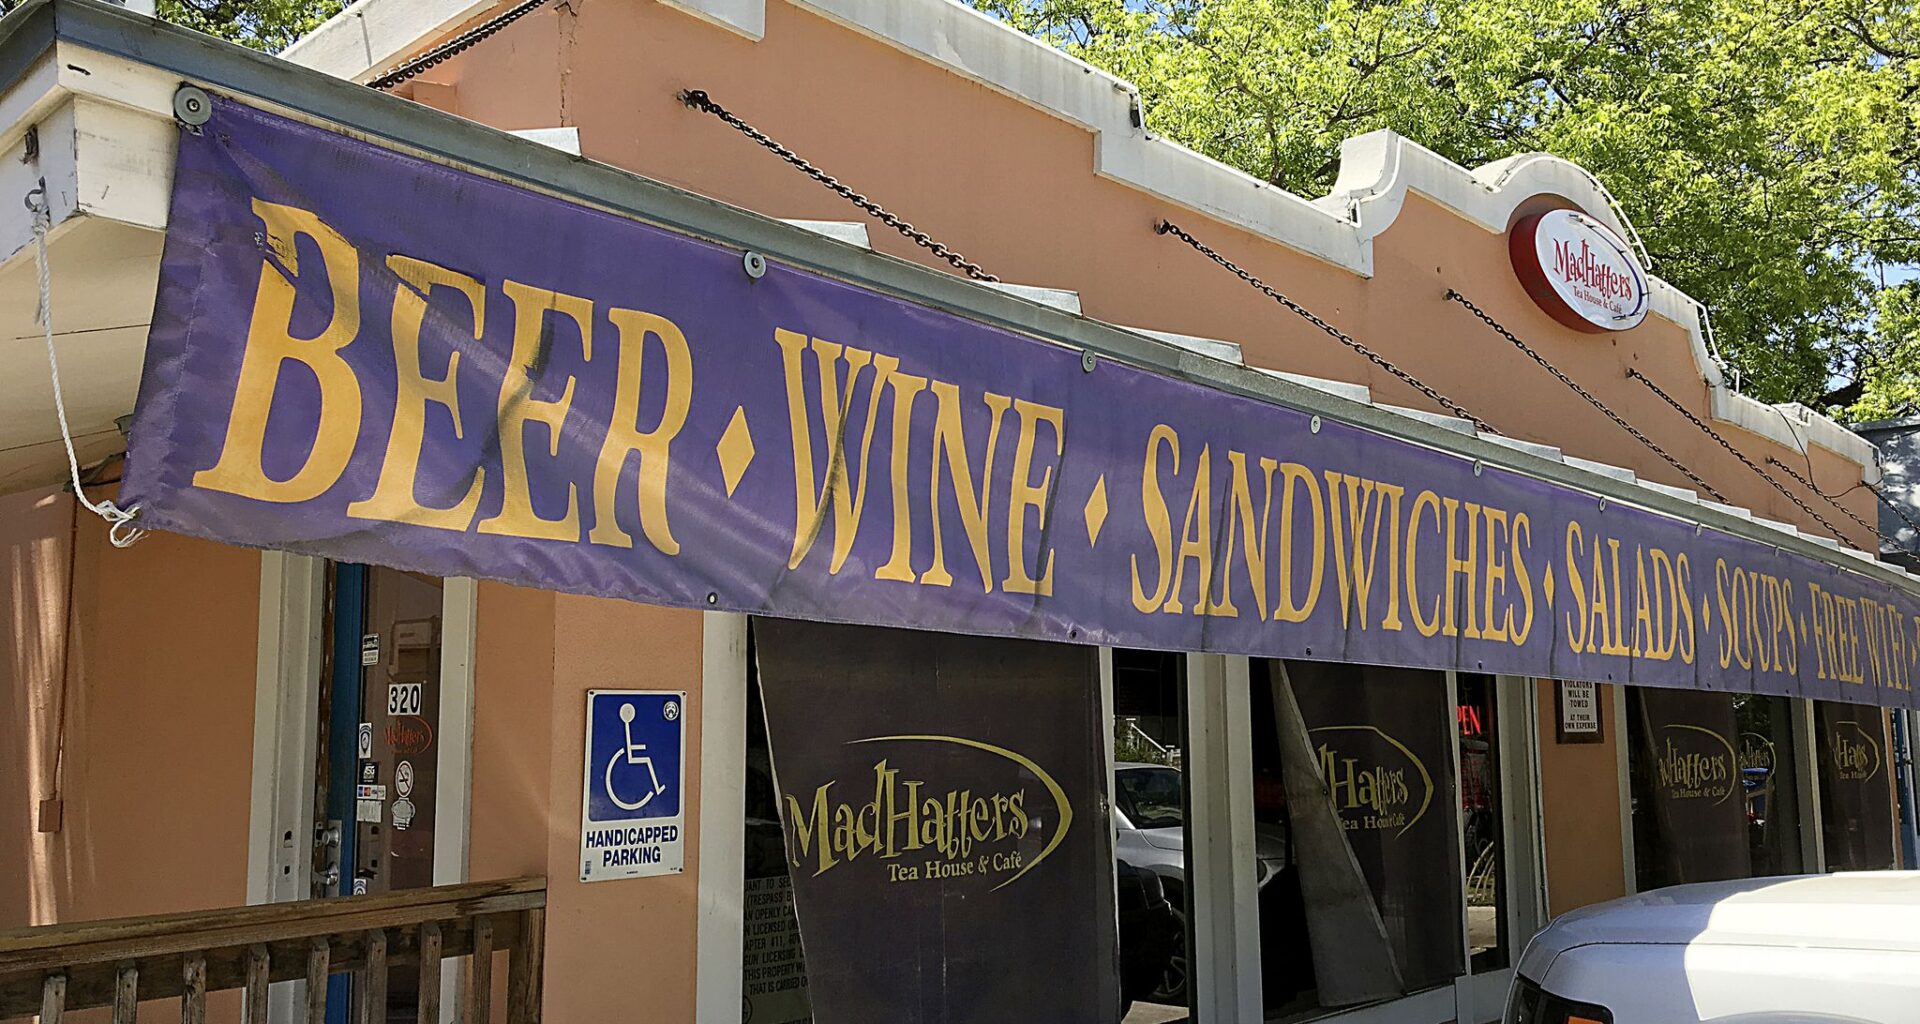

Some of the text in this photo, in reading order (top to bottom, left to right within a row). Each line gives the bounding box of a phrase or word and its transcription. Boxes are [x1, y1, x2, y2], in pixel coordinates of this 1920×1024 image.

[1553, 238, 1632, 301] MadHatters
[1573, 285, 1583, 298] Tea
[1584, 290, 1602, 306] House
[192, 197, 693, 555] BEER
[774, 327, 1064, 597] WINE
[1131, 424, 1534, 646] SANDWICHES
[1566, 521, 1695, 664] SALADS
[1715, 558, 1797, 675] SOUPS
[1808, 582, 1864, 684] FREE
[389, 685, 420, 714] 320
[1568, 690, 1589, 698] WILL BE
[1570, 699, 1589, 708] TOWED
[786, 758, 1028, 877] MadHatters
[586, 825, 678, 848] HANDICAPPED
[603, 846, 661, 867] PARKING
[887, 852, 1021, 882] Tea House & Café
[766, 878, 774, 889] TO
